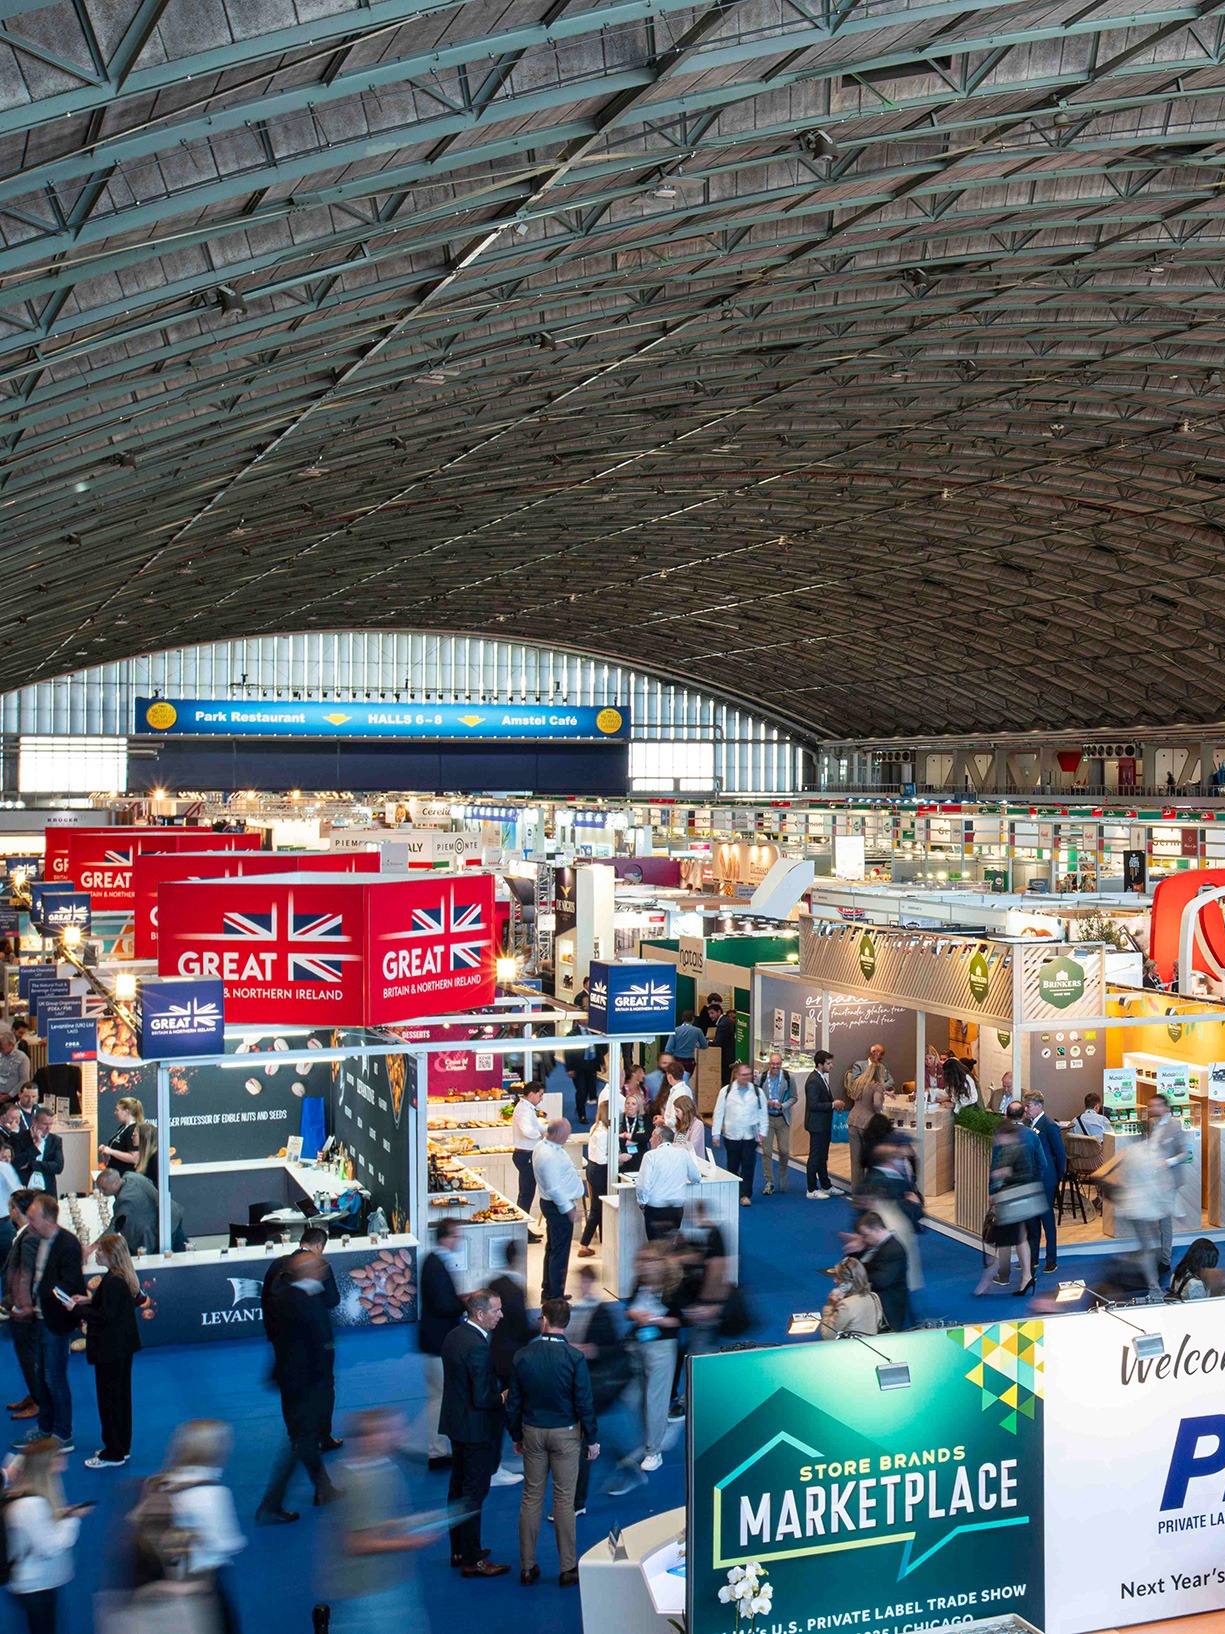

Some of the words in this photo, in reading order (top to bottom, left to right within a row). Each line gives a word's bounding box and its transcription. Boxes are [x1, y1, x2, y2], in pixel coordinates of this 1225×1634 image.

[195, 711, 226, 722] Park
[230, 711, 305, 723] Restaurant
[368, 713, 412, 725] HALLS
[502, 715, 546, 726] Amstel
[549, 715, 577, 726] Café
[407, 843, 423, 853] ALY
[81, 872, 133, 888] GREAT
[177, 951, 277, 981] GREAT
[382, 945, 445, 980] GREAT
[383, 986, 410, 999] BRITAIN
[411, 984, 416, 994] &
[417, 978, 453, 993] NORTHERN
[454, 974, 482, 987] IRELAND
[1043, 979, 1082, 988] BRINKERS
[223, 988, 230, 998] &
[233, 988, 293, 999] NORTHERN
[295, 989, 343, 1001] IRELAND
[614, 996, 649, 1007] GREAT
[150, 1017, 191, 1030] GREAT
[402, 1030, 430, 1039] DESSERTS
[180, 1114, 213, 1126] PROCESSOR
[213, 1113, 221, 1124] OF
[222, 1112, 241, 1123] EDIBLE
[241, 1111, 256, 1122] NUTS
[256, 1110, 268, 1121] AND
[269, 1109, 287, 1120] SEEDS
[201, 1308, 264, 1326] LEVANT
[800, 1458, 871, 1482] STORE
[879, 1445, 966, 1471] BRANDS
[740, 1458, 1017, 1547] MARKETPLACE
[1158, 1514, 1207, 1534] PRIVATE
[1121, 1578, 1165, 1600] Next
[1170, 1567, 1225, 1591] Year's
[772, 1621, 803, 1634] U.S.
[807, 1609, 871, 1631] PRIVATE
[875, 1601, 923, 1620] LABEL
[927, 1592, 978, 1611] TRADE
[981, 1583, 1027, 1602] SHOW
